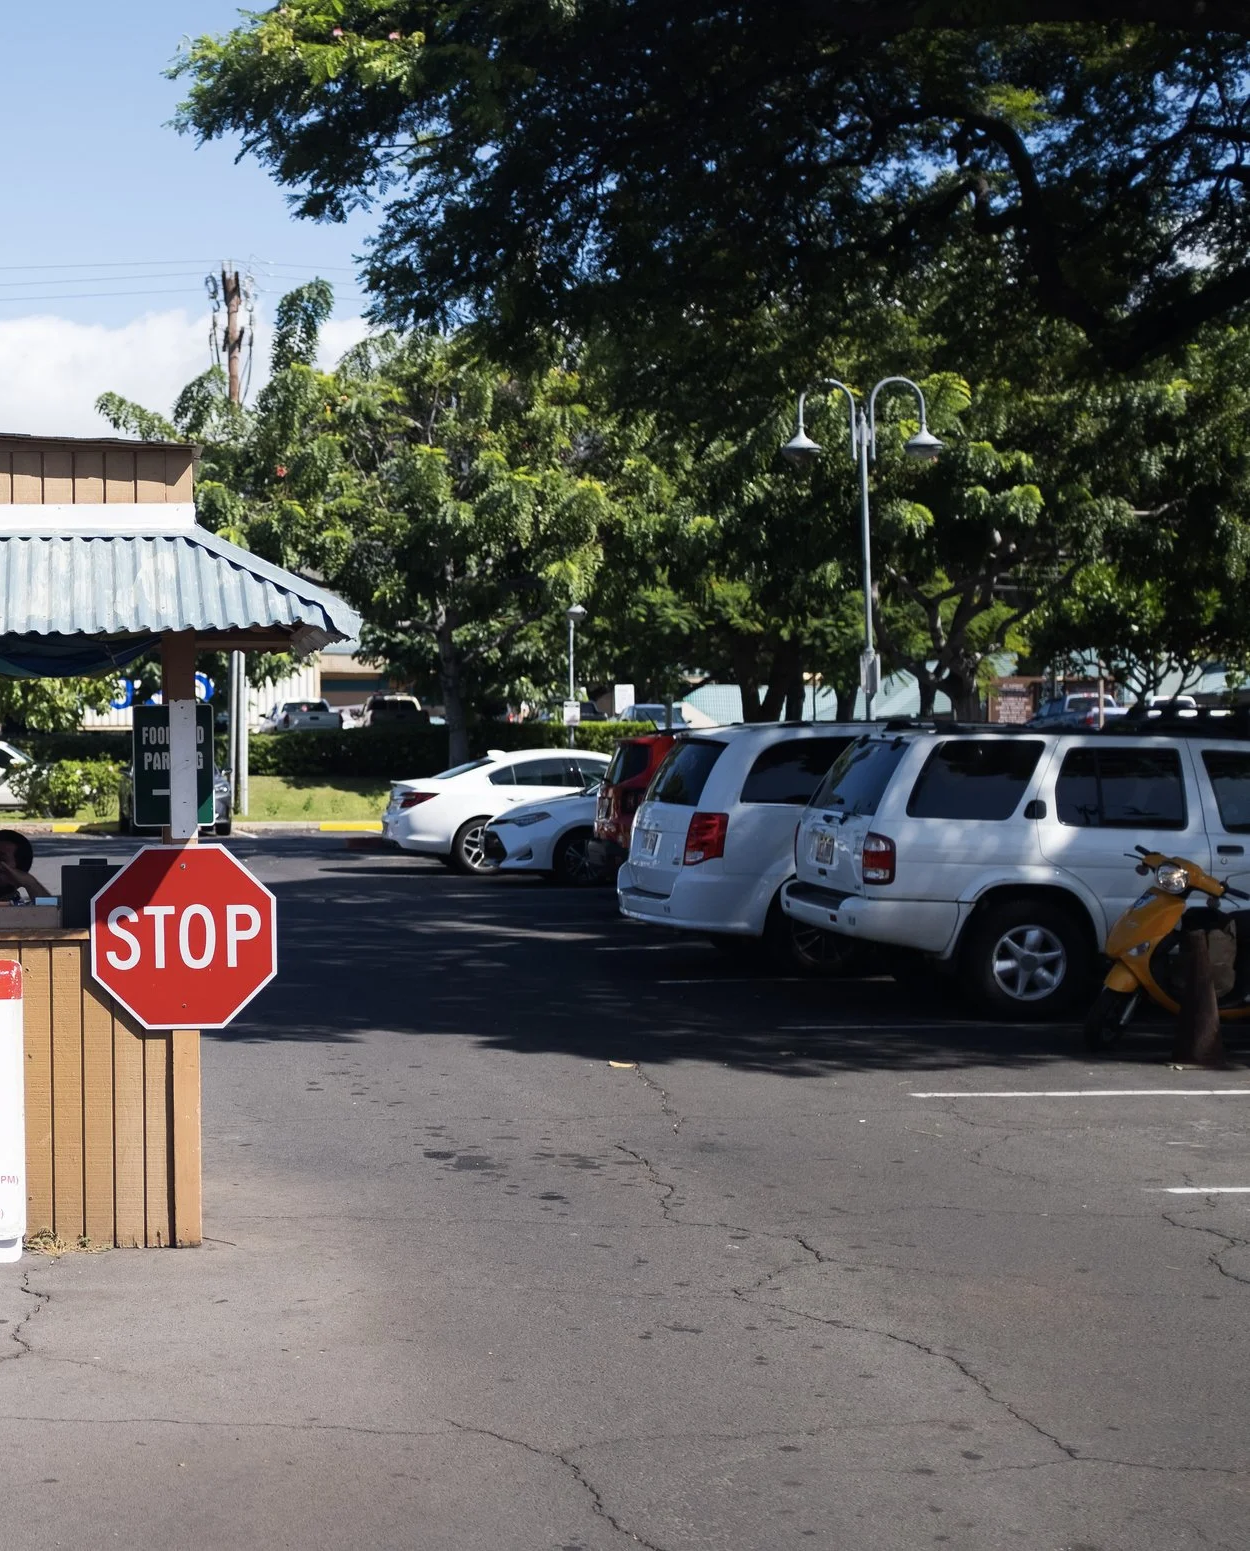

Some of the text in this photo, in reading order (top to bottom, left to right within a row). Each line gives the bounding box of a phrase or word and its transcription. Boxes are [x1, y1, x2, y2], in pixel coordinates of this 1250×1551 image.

[141, 725, 205, 746] FOOD
[143, 751, 204, 771] PARG
[105, 904, 262, 971] STOP
